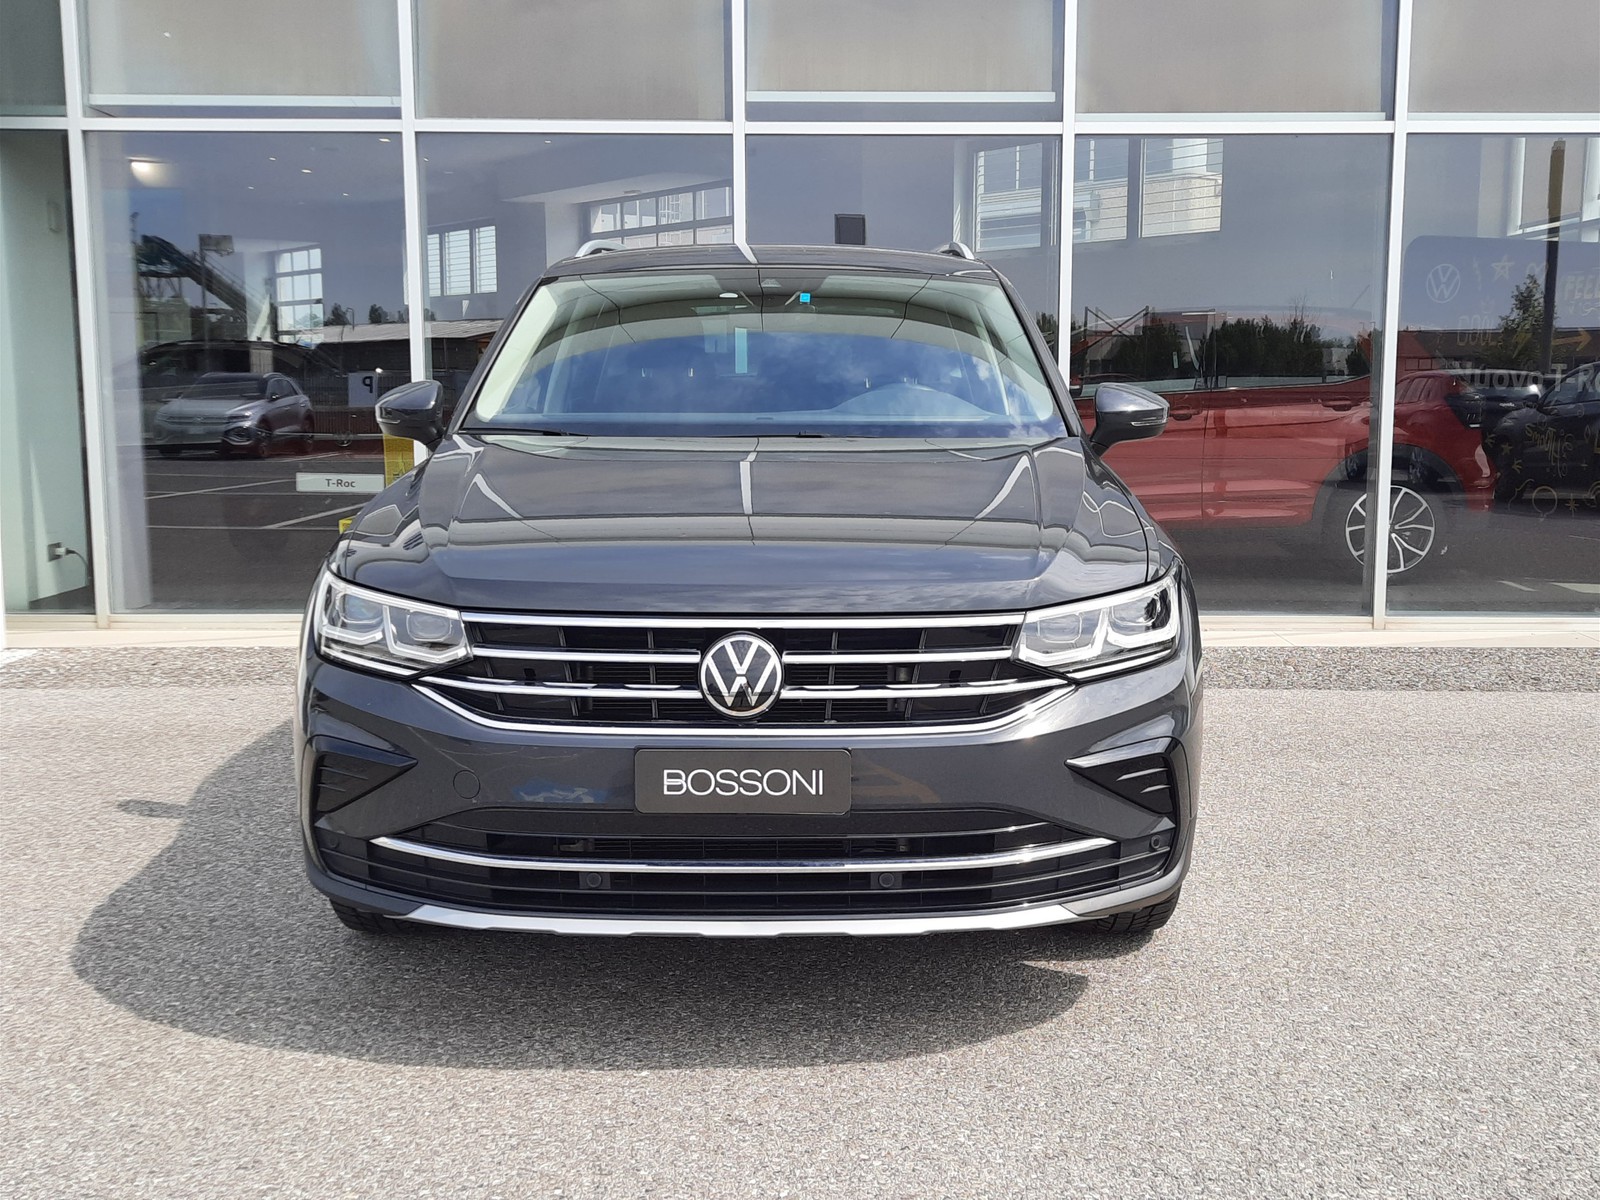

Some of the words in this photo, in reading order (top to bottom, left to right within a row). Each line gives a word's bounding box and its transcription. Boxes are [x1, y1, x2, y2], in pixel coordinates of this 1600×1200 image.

[325, 478, 356, 488] T-Roc
[702, 636, 781, 713] VW
[663, 769, 824, 796] BOSSONI
